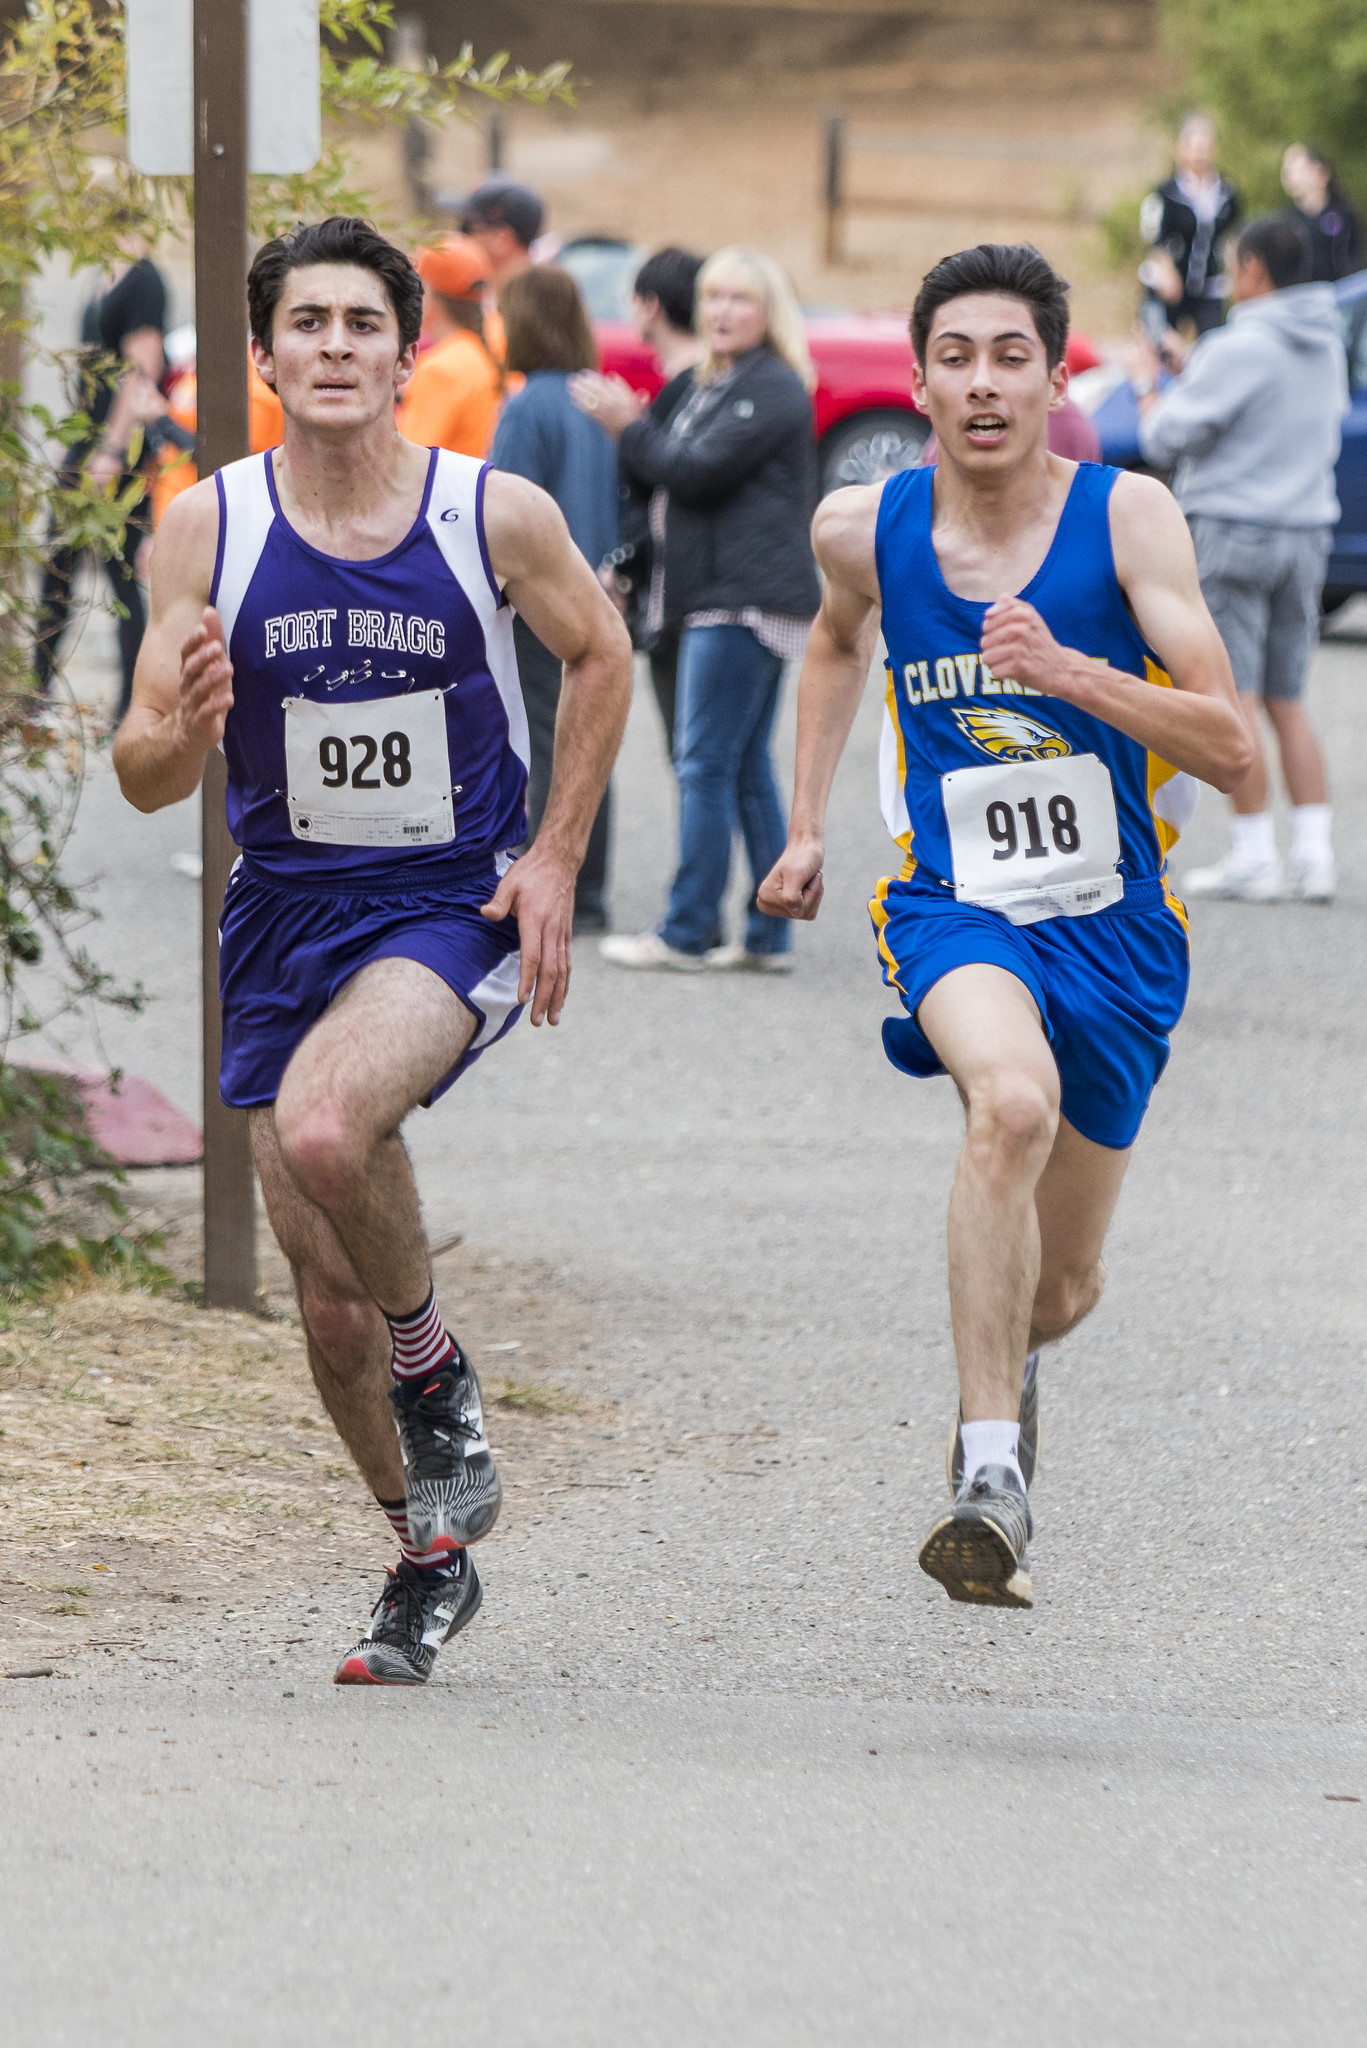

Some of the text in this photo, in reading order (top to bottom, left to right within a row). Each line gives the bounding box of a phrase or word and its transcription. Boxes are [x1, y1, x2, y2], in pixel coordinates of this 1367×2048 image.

[265, 609, 446, 658] FORT BRAGG
[903, 653, 1110, 706] CLOVE
[319, 731, 412, 789] 928
[985, 795, 1081, 861] 918
